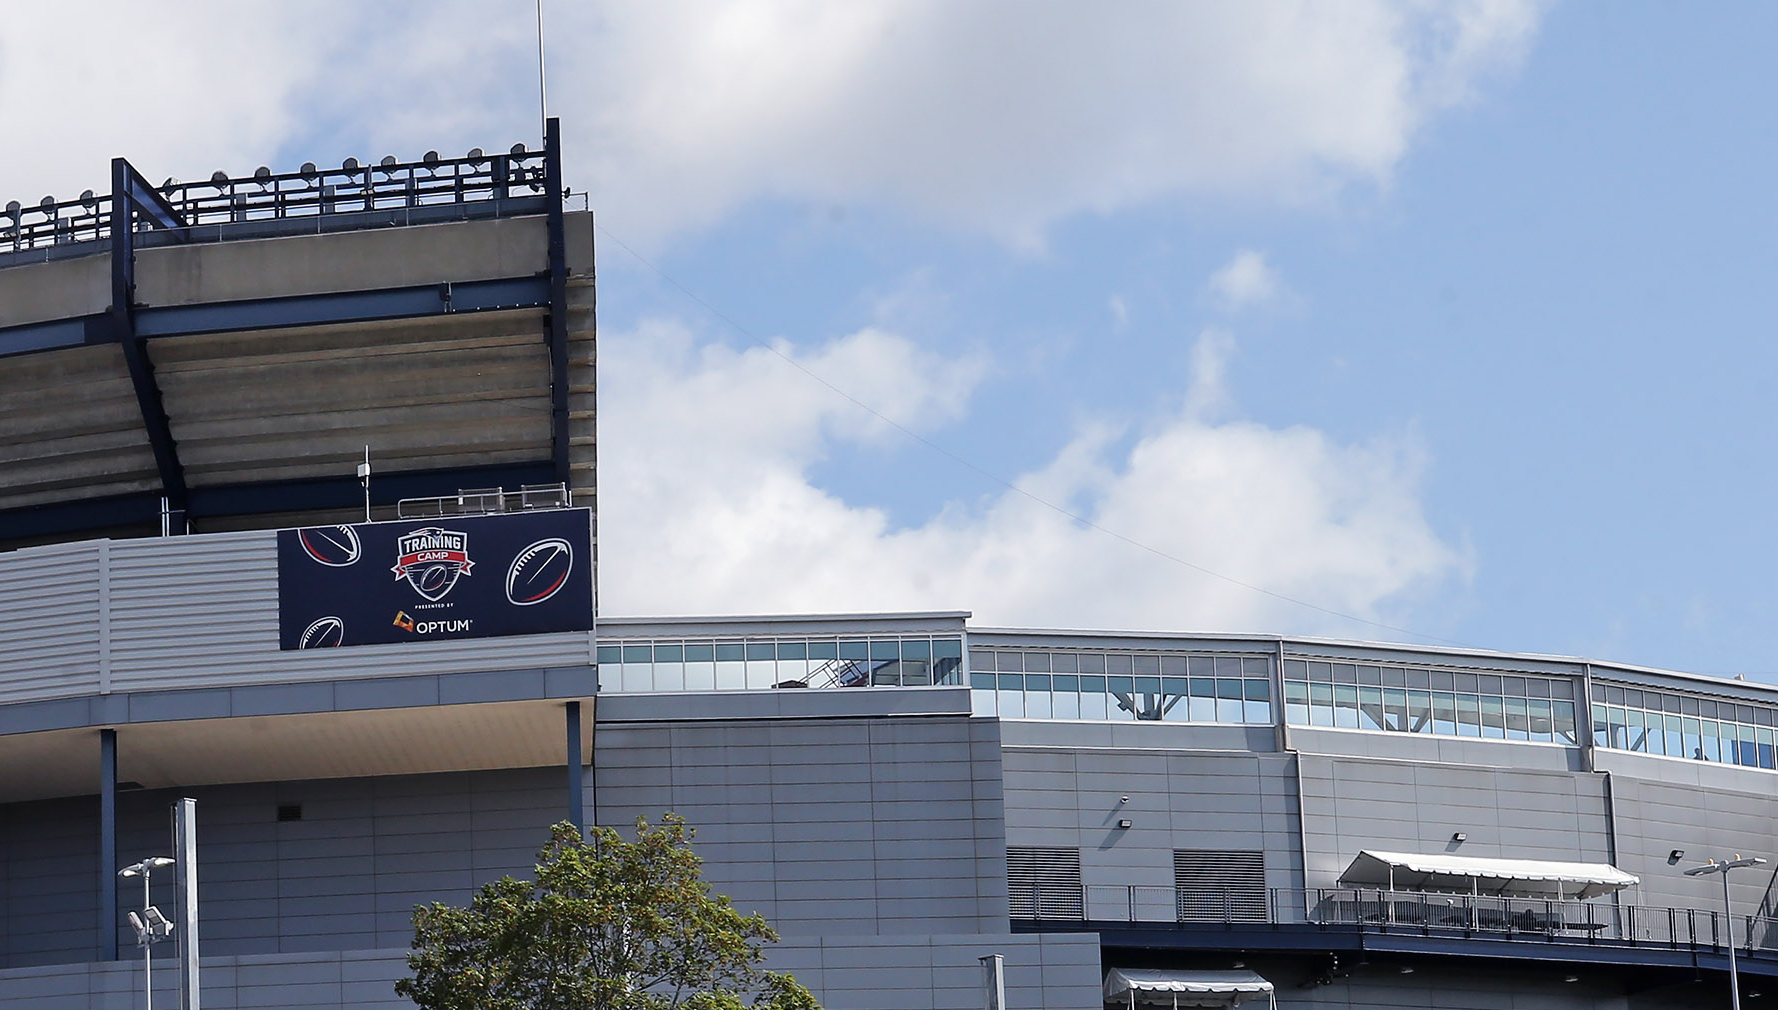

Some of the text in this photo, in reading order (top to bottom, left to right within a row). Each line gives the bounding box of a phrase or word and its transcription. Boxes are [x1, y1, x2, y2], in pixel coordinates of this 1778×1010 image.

[404, 535, 461, 553] TRAINING
[417, 551, 449, 562] CAMP
[416, 619, 469, 634] OPTUM
